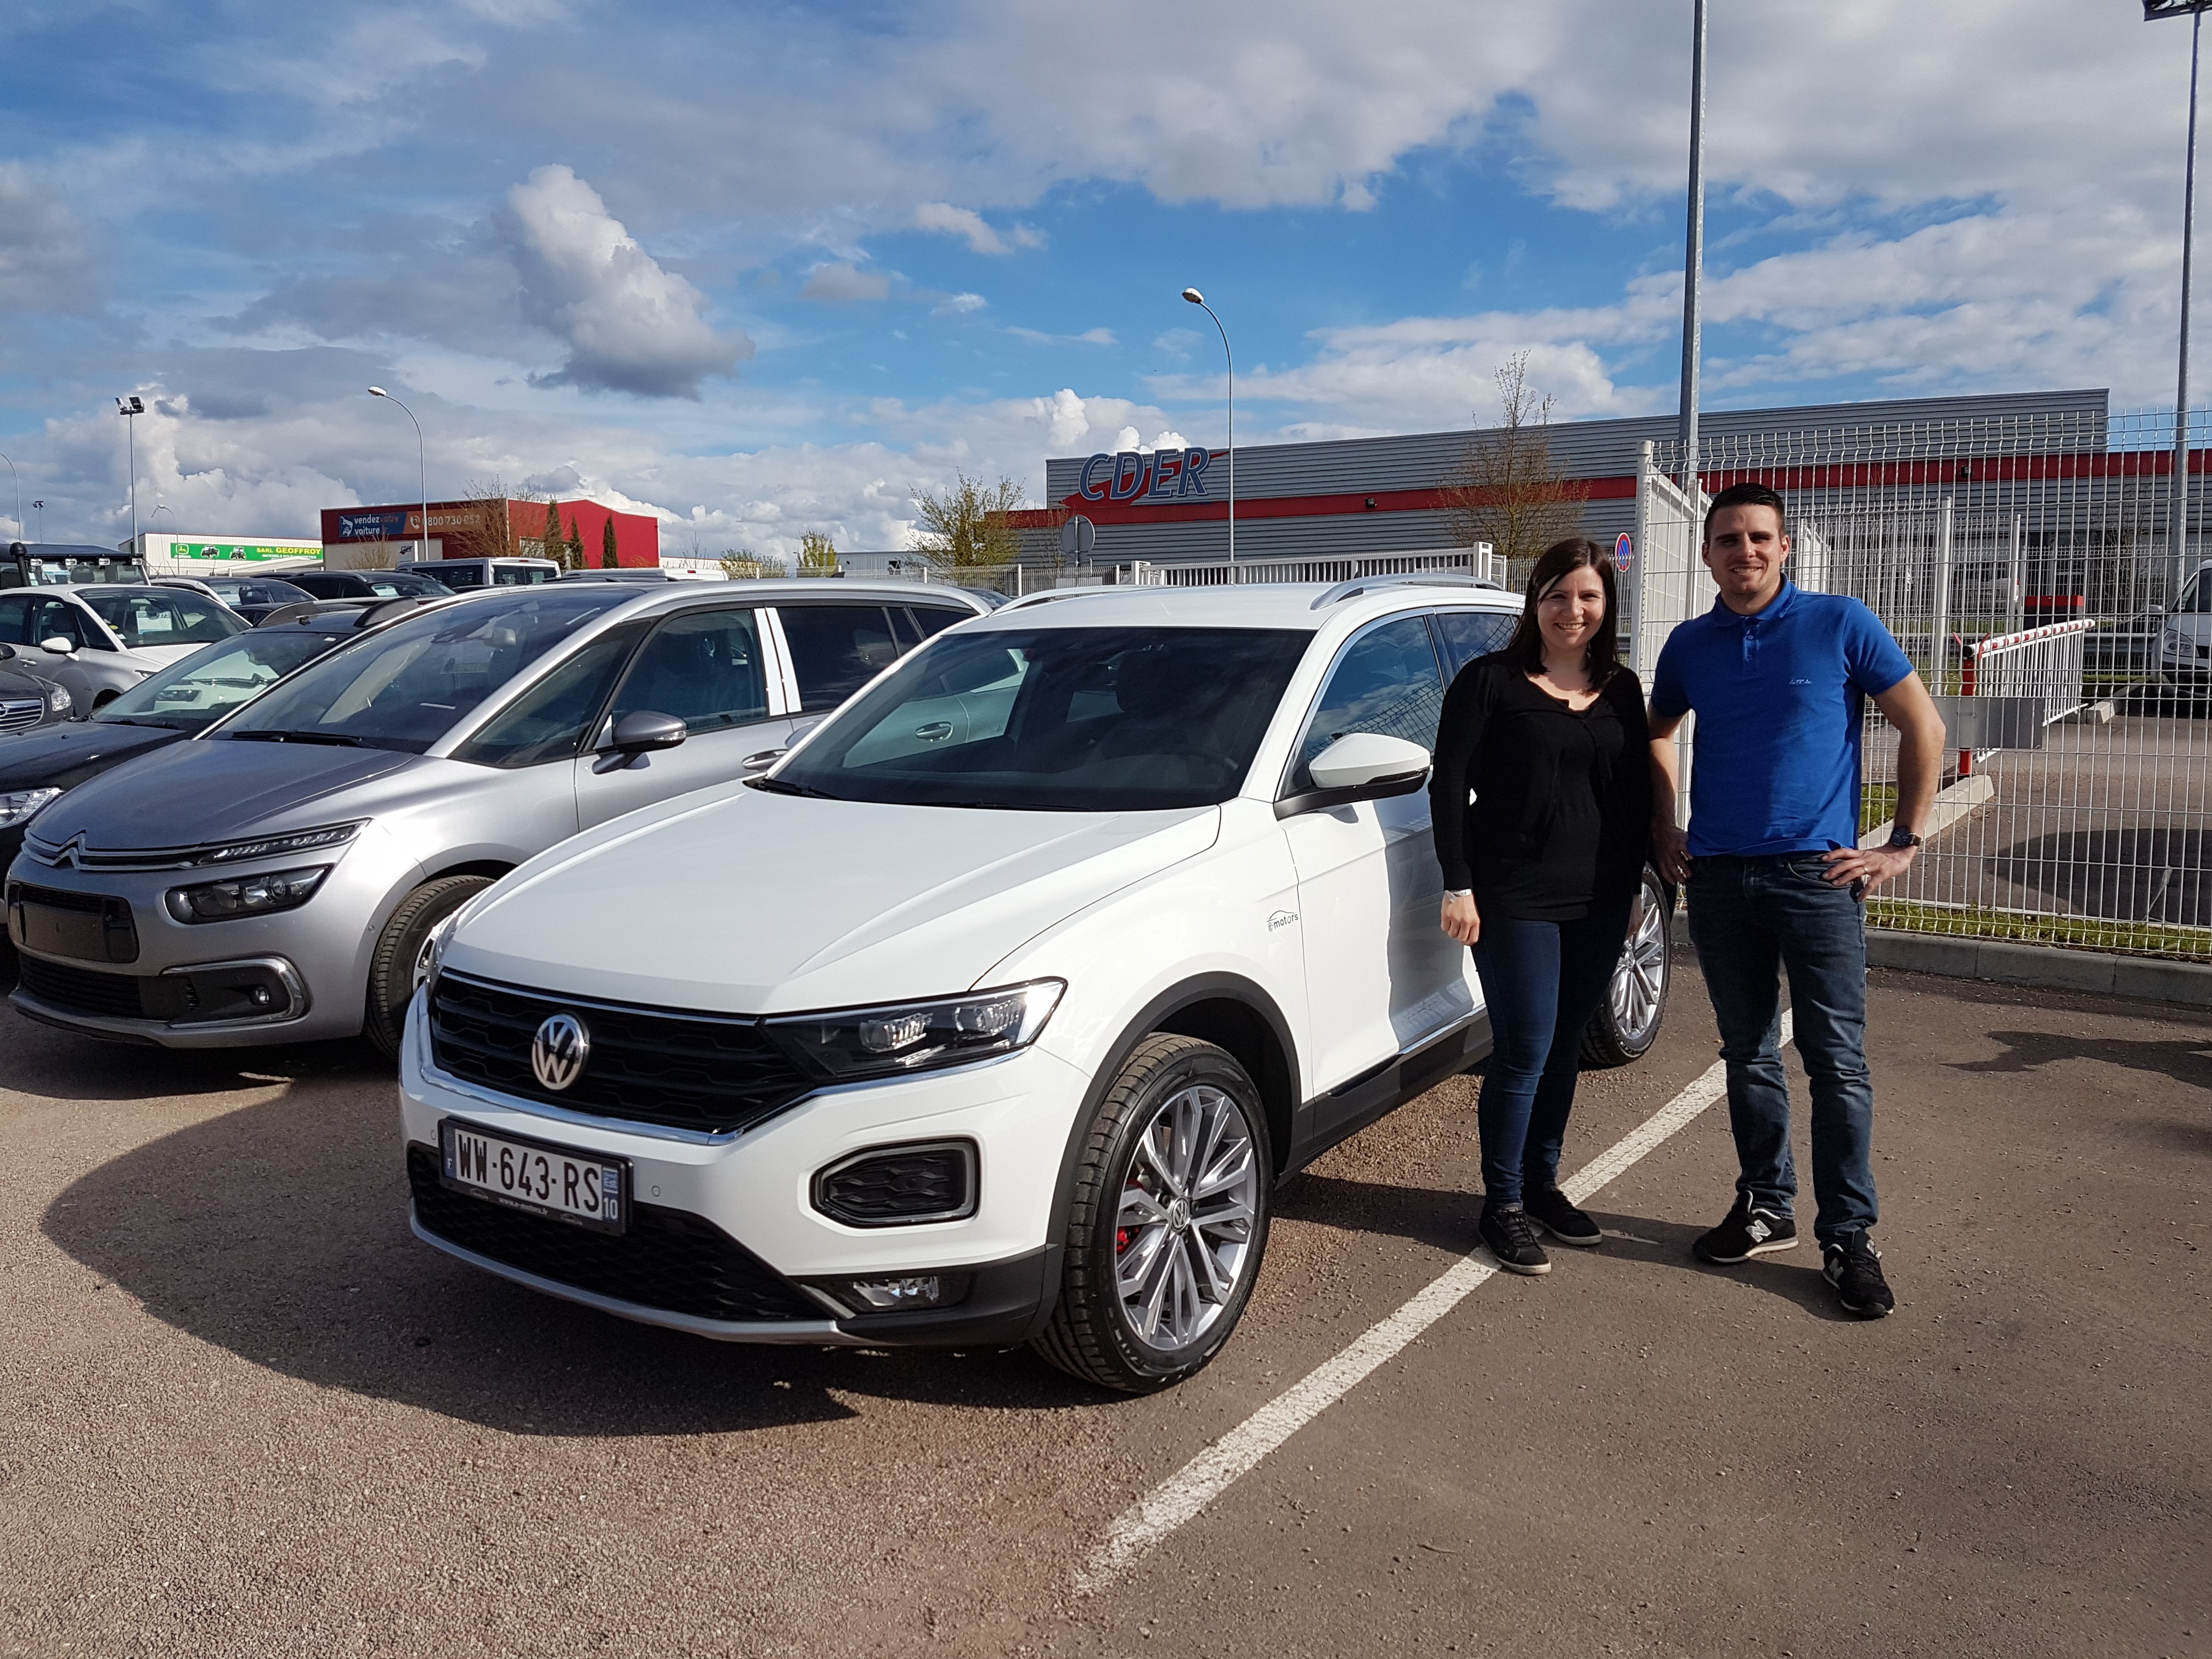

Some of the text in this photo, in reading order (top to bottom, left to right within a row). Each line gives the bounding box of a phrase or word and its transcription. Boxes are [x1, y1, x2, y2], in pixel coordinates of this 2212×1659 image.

[1079, 447, 1210, 501] CDER
[354, 514, 380, 524] vendez
[446, 516, 461, 525] 730
[354, 526, 380, 535] voiture
[447, 1158, 453, 1170] F
[458, 1134, 599, 1212] WW-643-RS
[603, 1197, 618, 1220] 10
[1746, 1220, 1771, 1242] N
